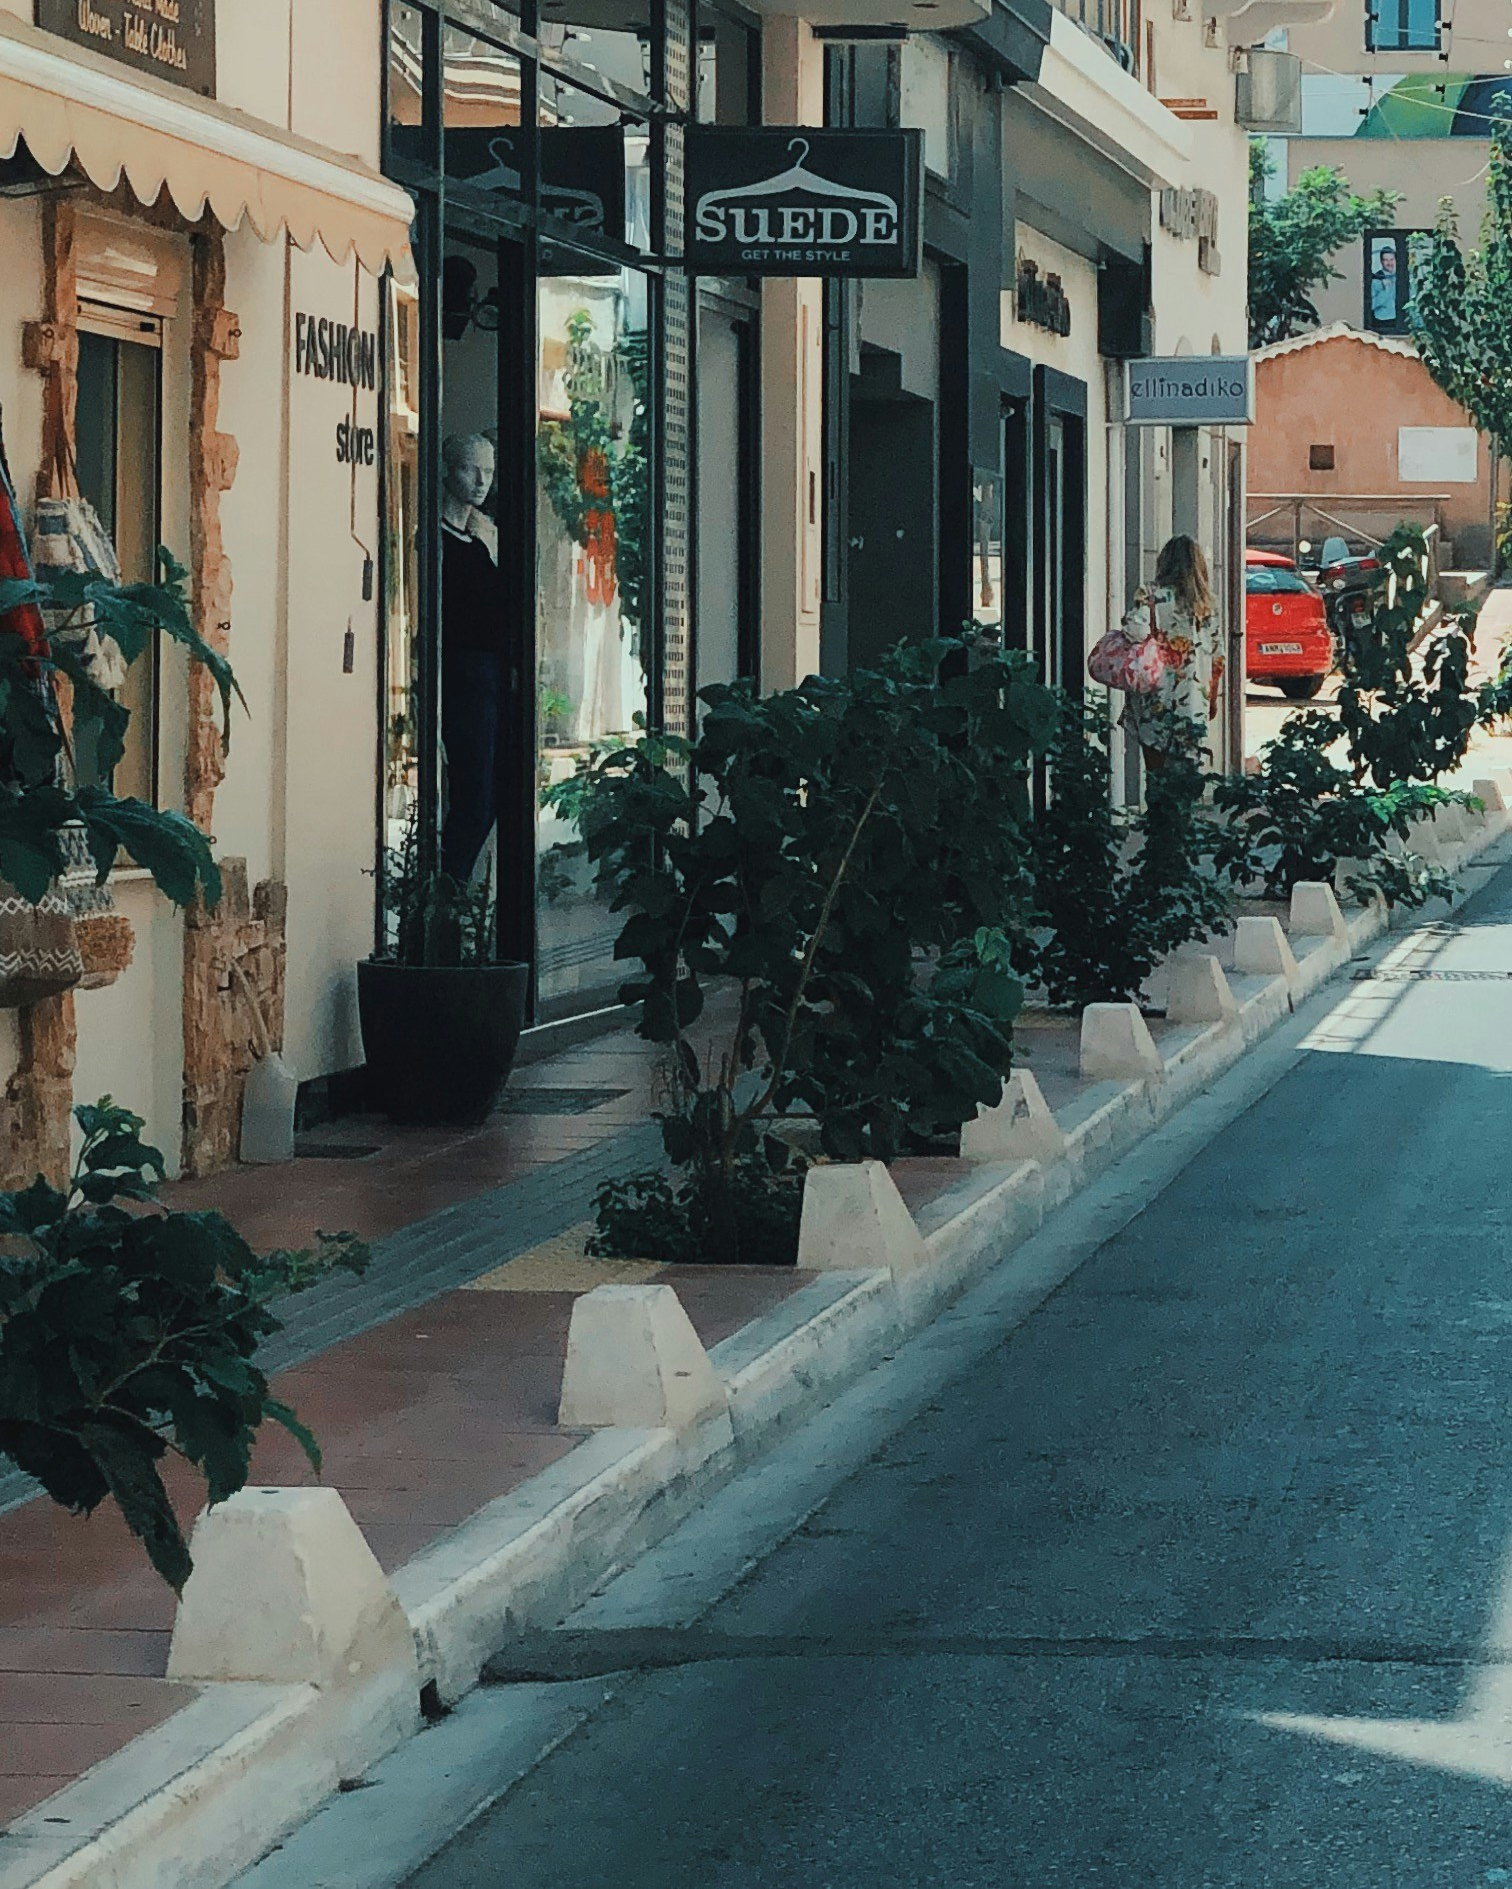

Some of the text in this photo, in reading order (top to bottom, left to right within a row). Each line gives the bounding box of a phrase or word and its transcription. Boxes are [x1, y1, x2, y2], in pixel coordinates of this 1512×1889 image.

[123, 12, 149, 55] Table
[741, 249, 851, 261] GET THE STYLE
[295, 312, 375, 391] FASHION
[336, 412, 374, 466] store
